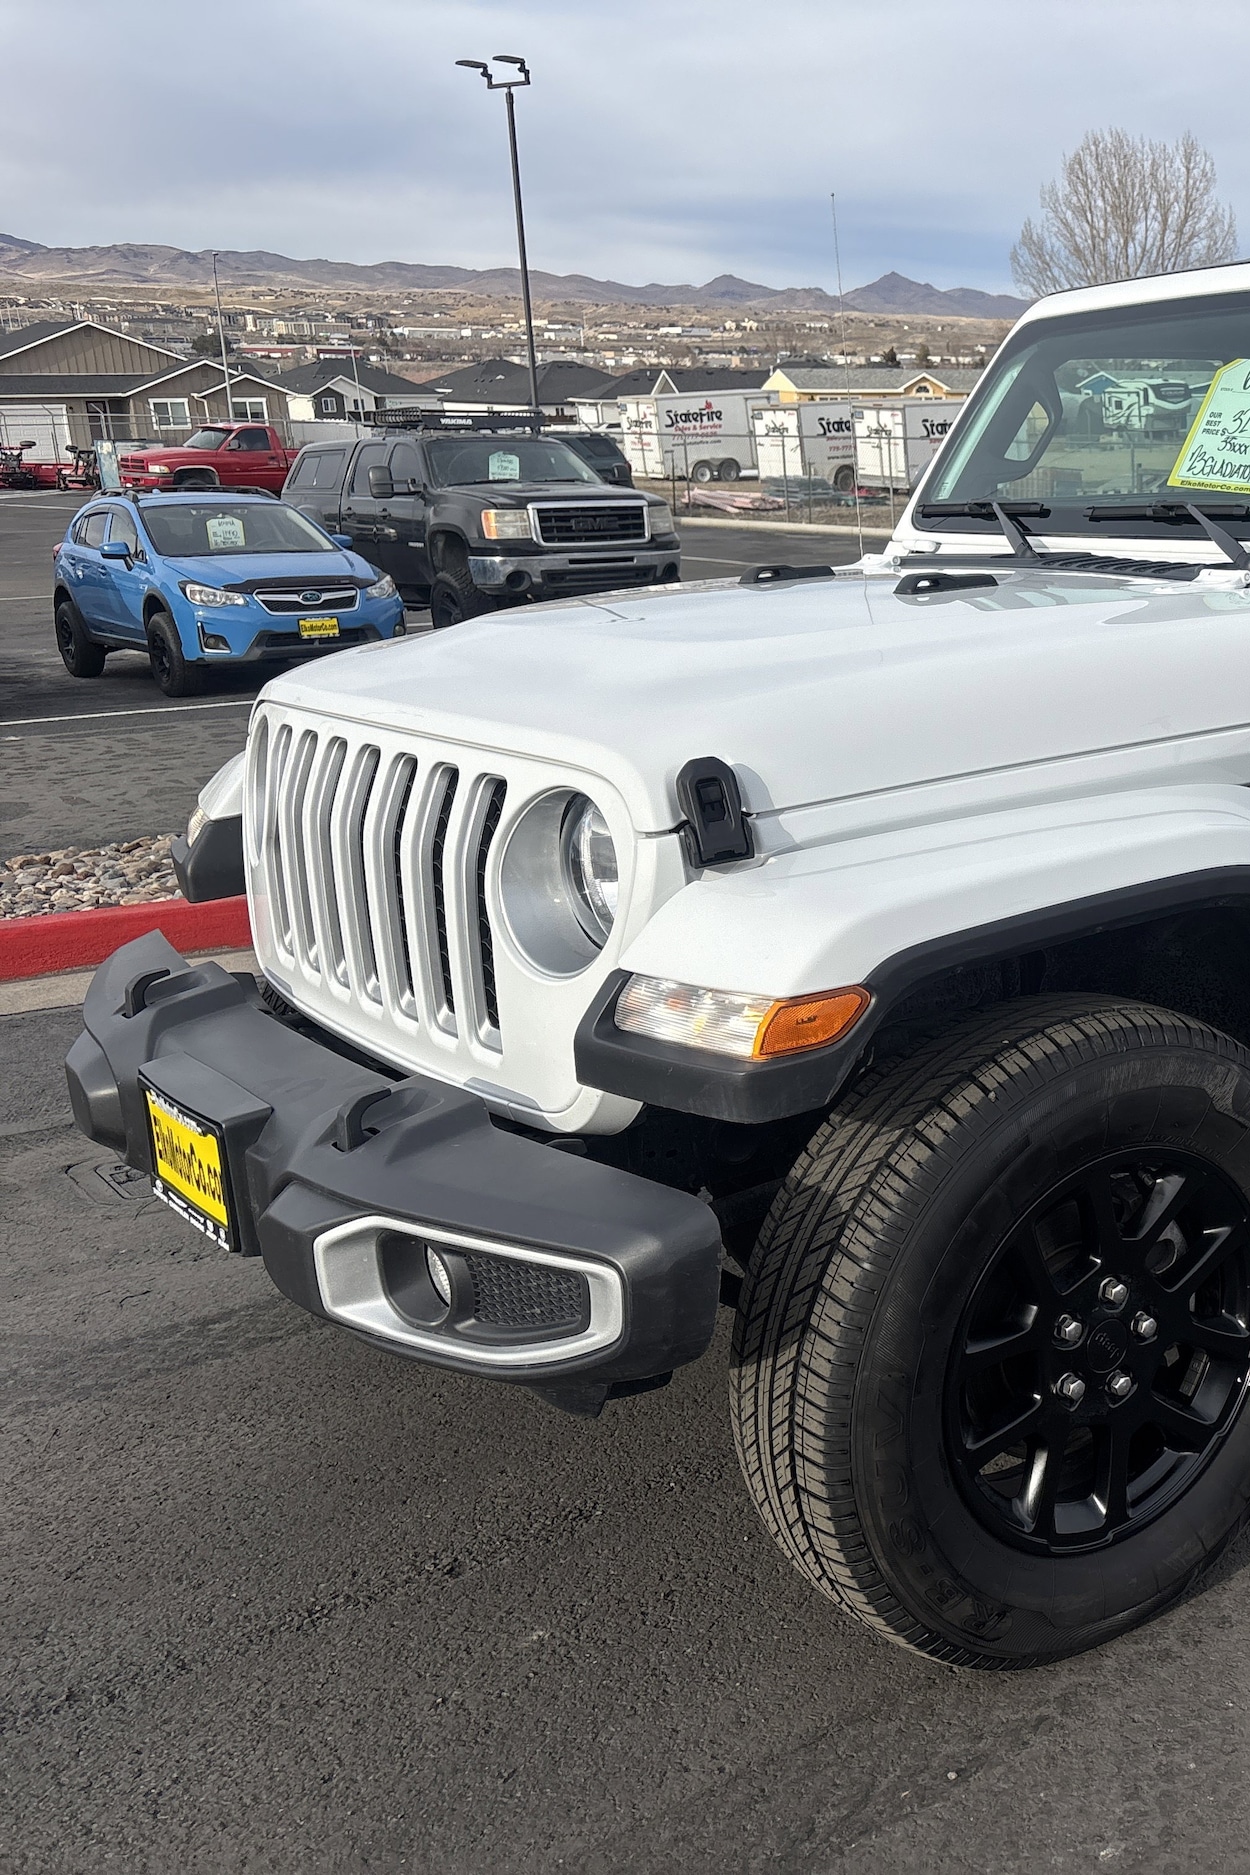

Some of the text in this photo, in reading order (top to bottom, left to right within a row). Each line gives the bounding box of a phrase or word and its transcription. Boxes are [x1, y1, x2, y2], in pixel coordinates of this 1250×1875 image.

[440, 417, 472, 425] YAKIMA
[919, 418, 954, 437] Stat
[1202, 428, 1220, 436] PRICE
[1180, 480, 1250, 492] ElkoMotorCo.com
